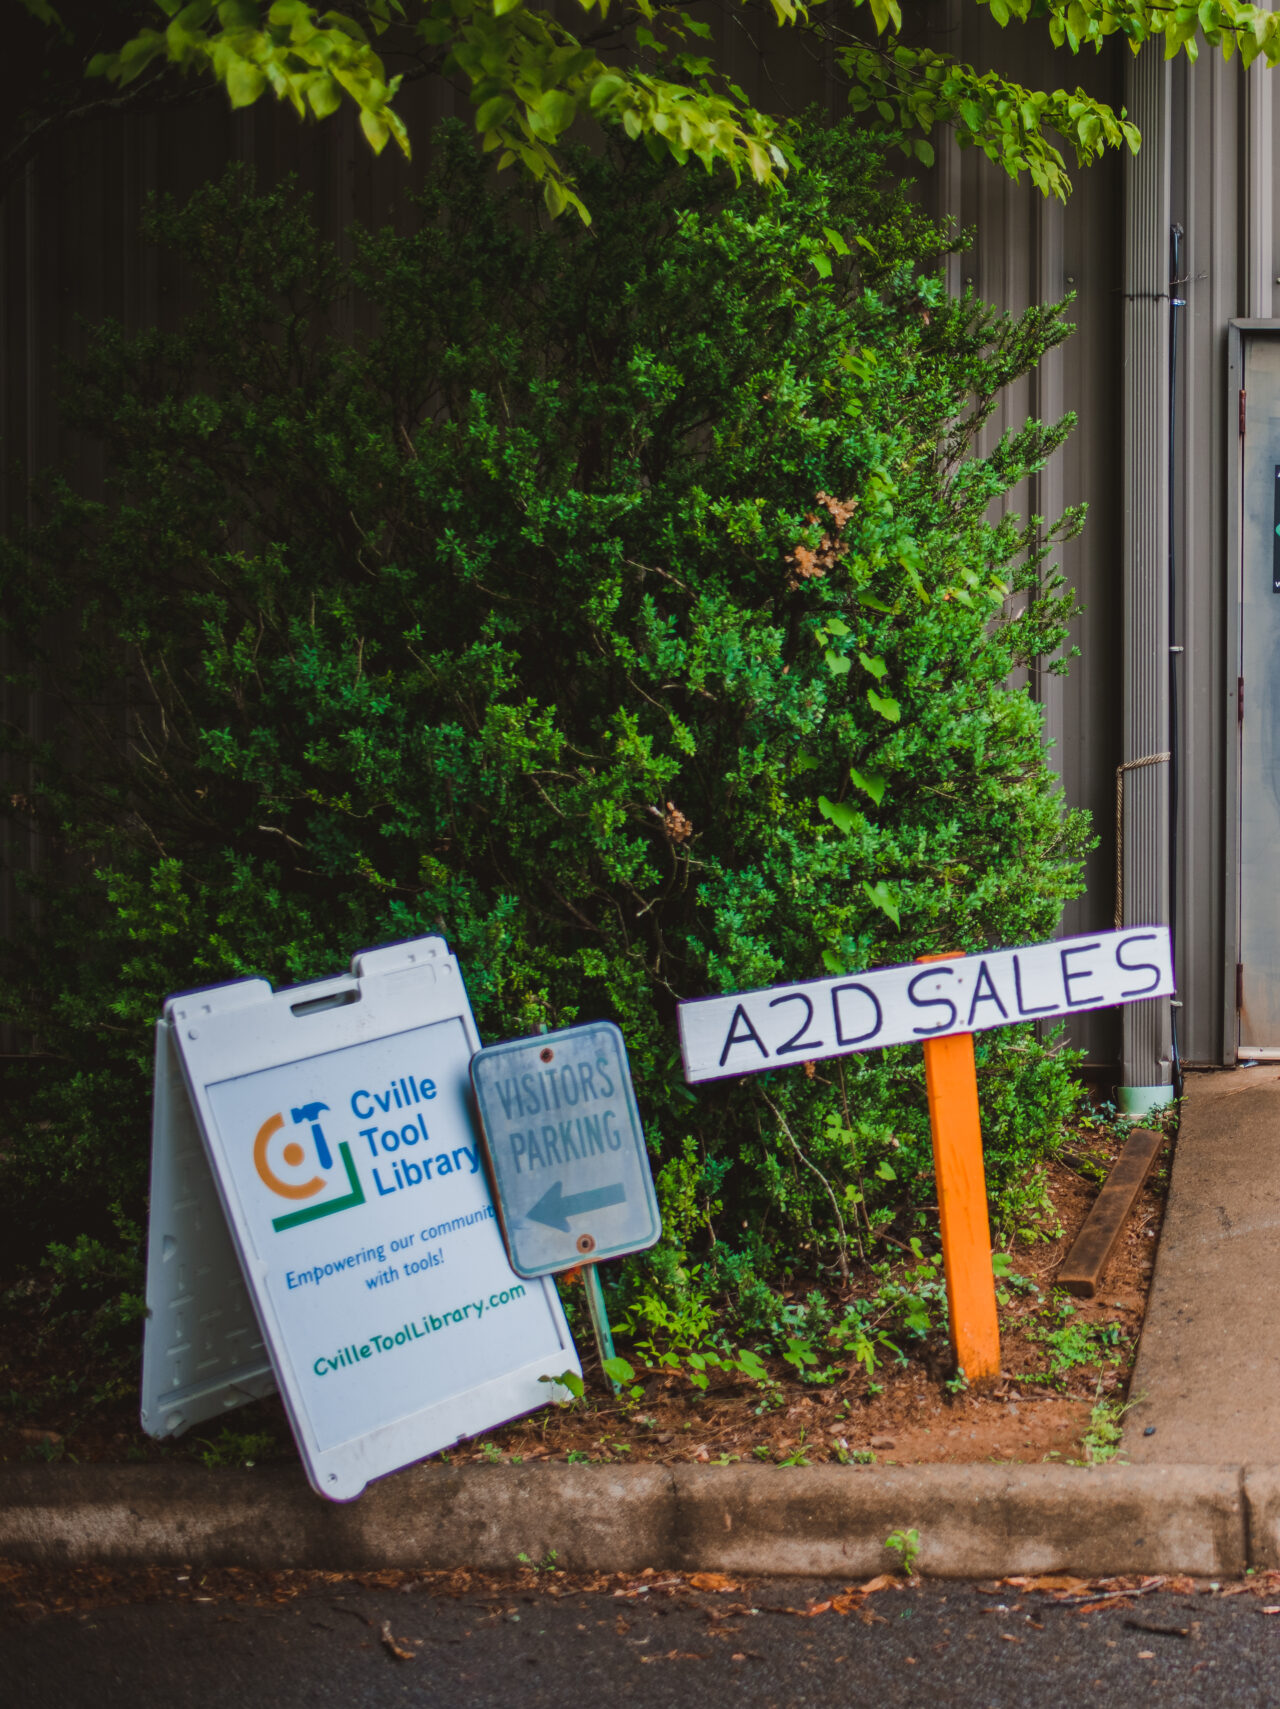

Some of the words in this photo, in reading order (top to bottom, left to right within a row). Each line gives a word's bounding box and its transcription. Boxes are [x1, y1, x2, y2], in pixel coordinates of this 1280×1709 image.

[718, 981, 884, 1067] A2D
[907, 933, 1163, 1036] SALES
[350, 1075, 438, 1120] Cville
[494, 1056, 616, 1121] VISITORS
[358, 1112, 430, 1158] Tool
[509, 1109, 622, 1174] PARKING
[371, 1143, 480, 1197] Library
[285, 1244, 388, 1291] Empowering
[389, 1232, 416, 1254] our
[419, 1203, 495, 1243] communit
[365, 1265, 401, 1291] with
[402, 1247, 446, 1278] tools!
[312, 1284, 527, 1377] CvilleToolLibrary.com
